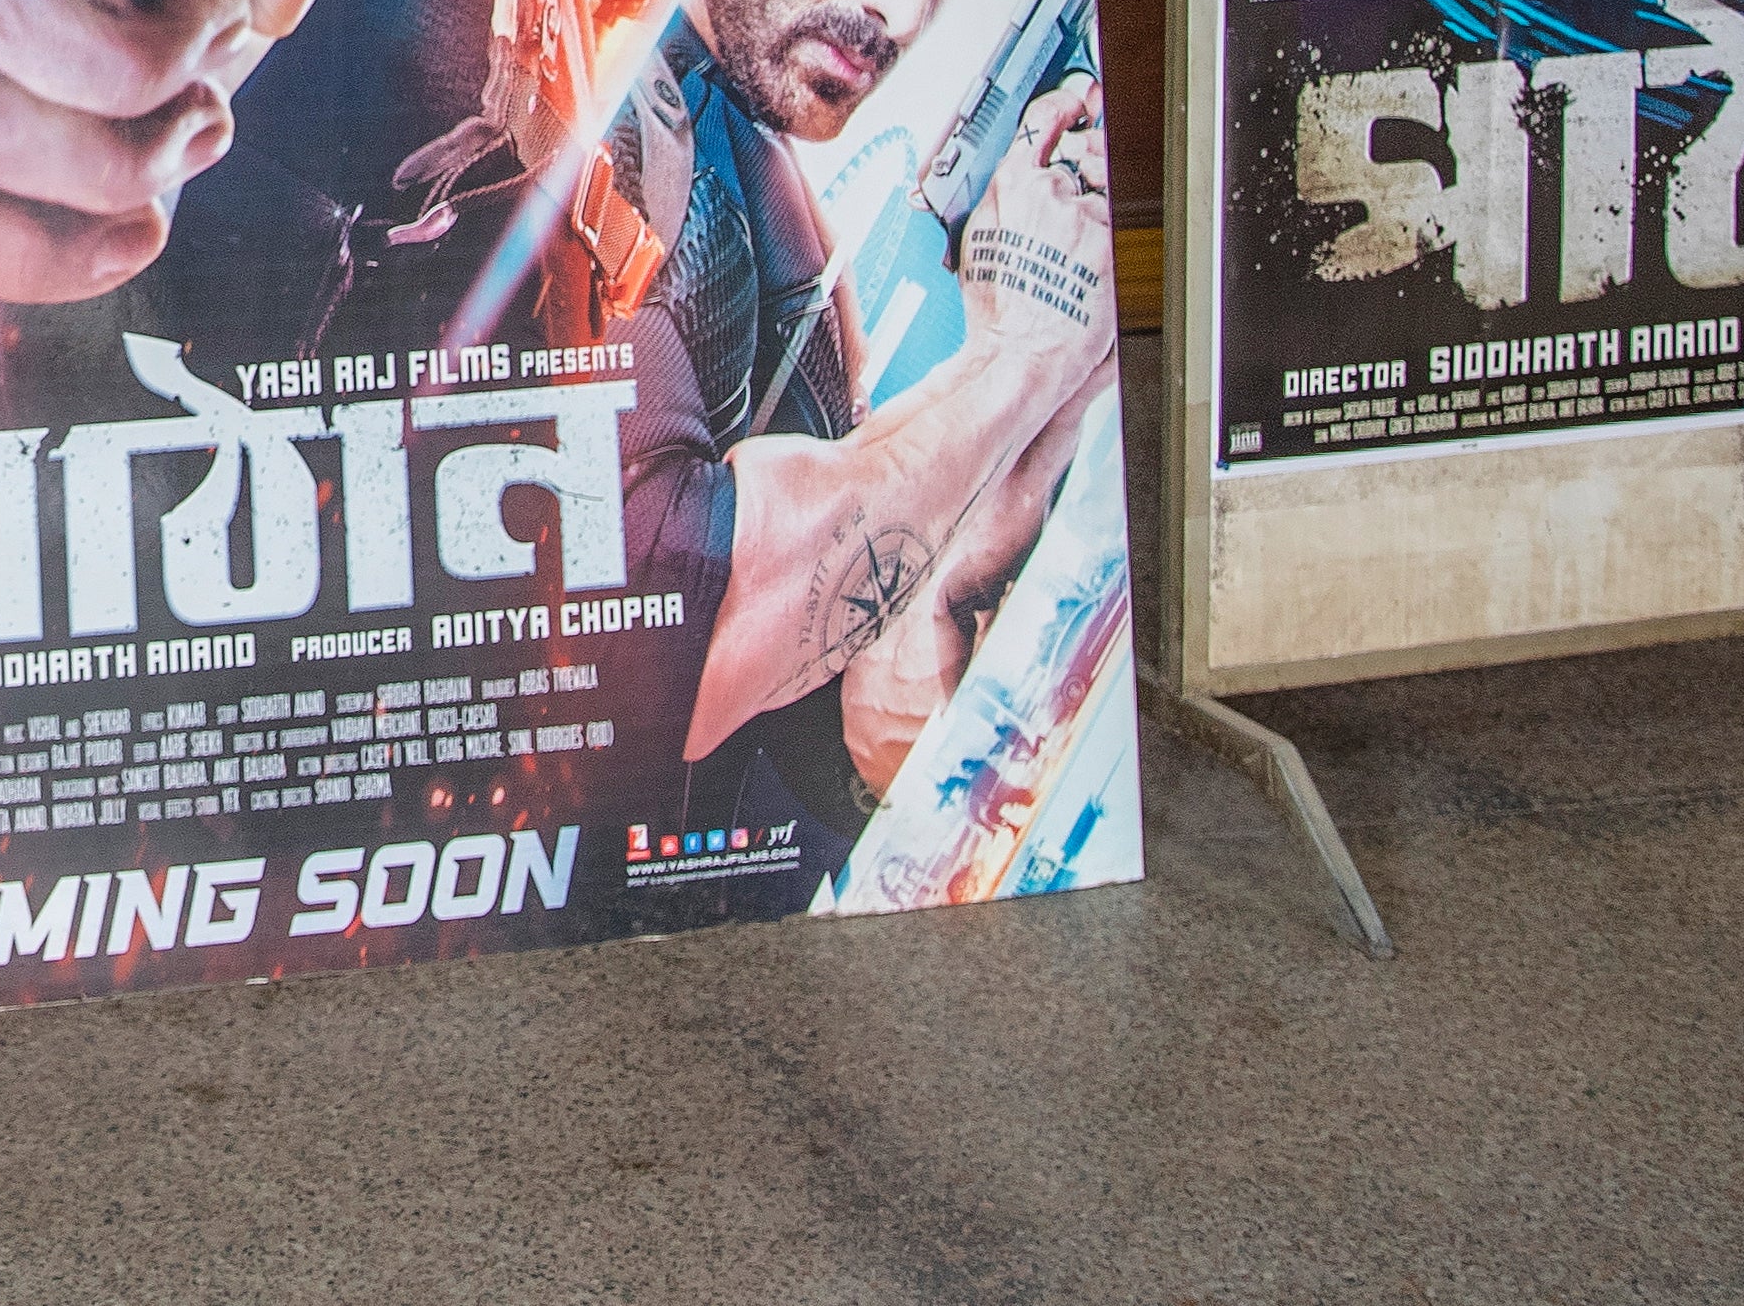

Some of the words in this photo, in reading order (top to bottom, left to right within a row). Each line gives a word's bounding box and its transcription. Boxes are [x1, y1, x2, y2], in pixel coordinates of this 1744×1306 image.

[1068, 283, 1087, 305] MY
[236, 357, 323, 402] YASH
[333, 351, 396, 395] RAJ
[408, 342, 512, 390] FILMS
[519, 342, 635, 380] PRESENTS
[1283, 358, 1407, 400] DIRECTOR
[1428, 327, 1621, 386] SIDDHARTH
[1629, 316, 1742, 365] ANAND
[145, 631, 257, 677] ANAND
[290, 626, 412, 665] PRODUCER
[431, 604, 551, 651] ADITYA
[560, 591, 685, 638] CHOPRA
[287, 823, 582, 939] SOON
